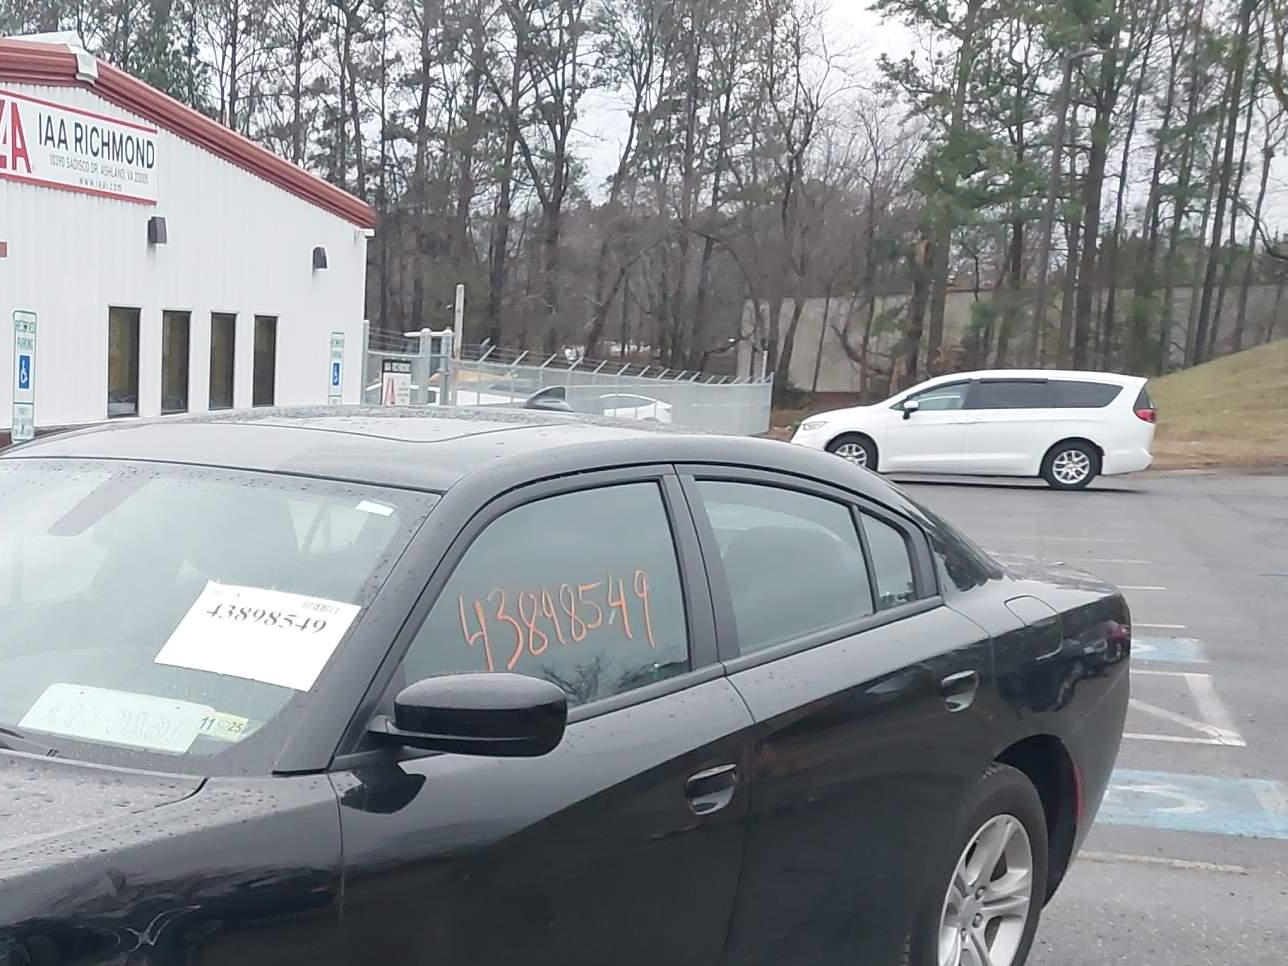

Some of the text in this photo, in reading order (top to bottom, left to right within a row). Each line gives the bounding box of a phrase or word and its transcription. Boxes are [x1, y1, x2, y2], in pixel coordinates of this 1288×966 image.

[38, 112, 155, 169] IAA RICHMOND
[66, 156, 90, 174] SADISCO
[127, 170, 134, 181] VA
[206, 603, 327, 634] 43898549
[458, 569, 655, 673] 43898549
[200, 716, 244, 733] 11 25
